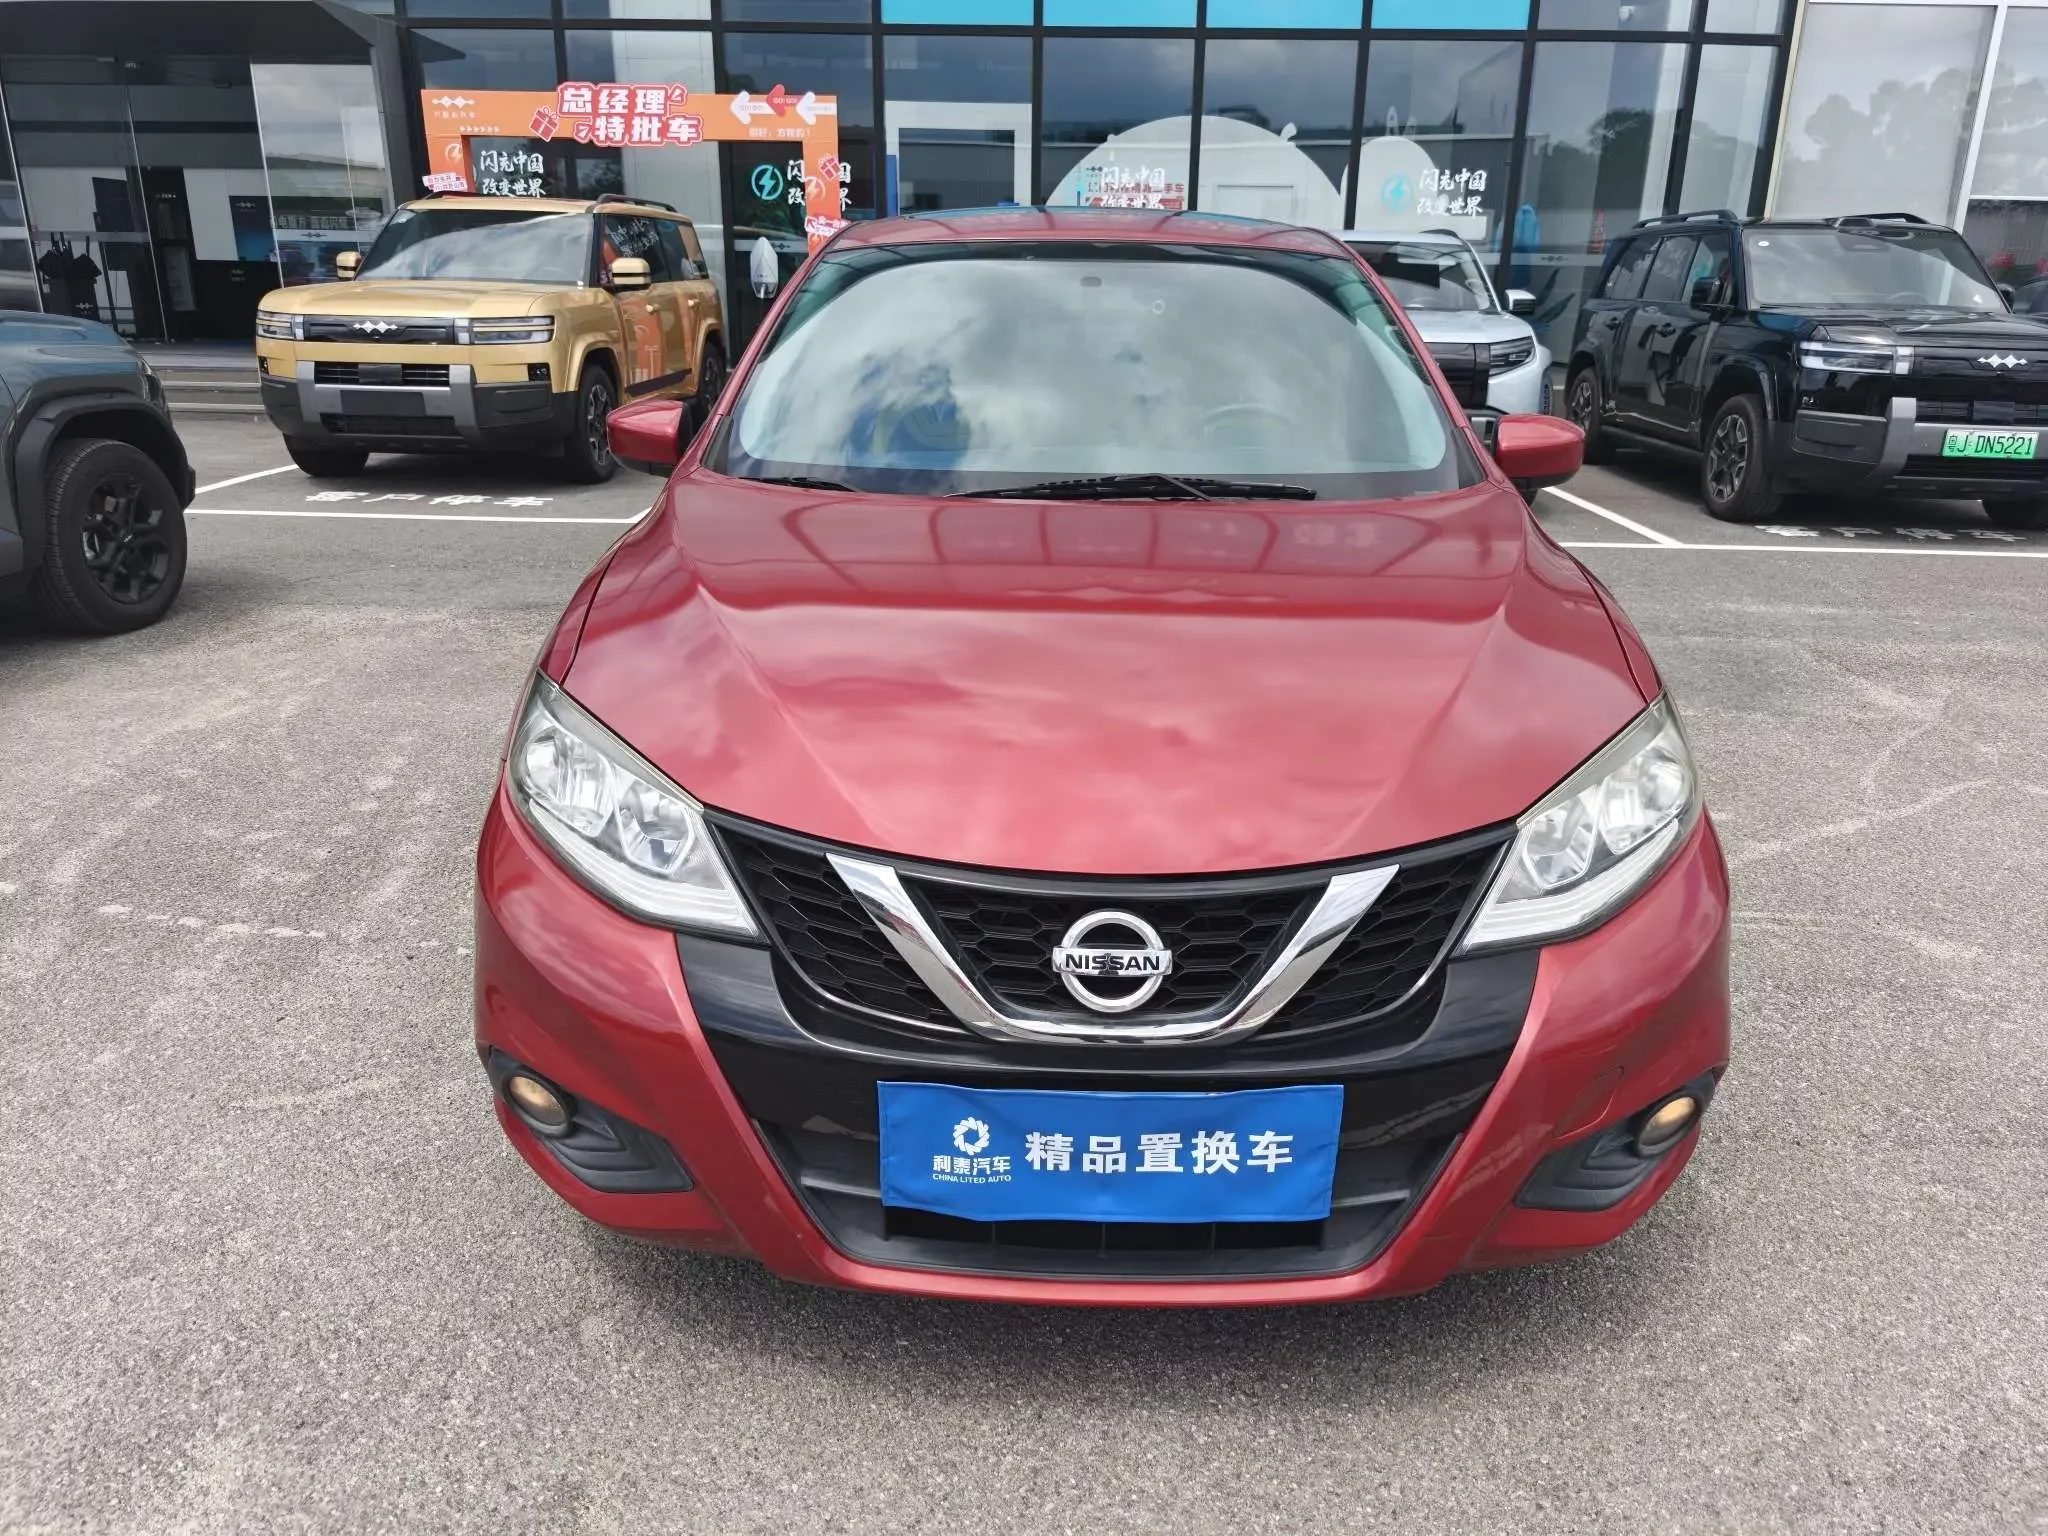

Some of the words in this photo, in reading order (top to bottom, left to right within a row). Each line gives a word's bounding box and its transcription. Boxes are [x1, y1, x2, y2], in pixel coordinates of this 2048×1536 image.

[562, 87, 666, 114] 总经理
[594, 115, 698, 142] 特批车
[480, 150, 544, 174] 闪充中国
[482, 177, 546, 198] 改变世界
[1419, 168, 1487, 192] 闪充中国
[1065, 954, 1160, 971] NISSAN
[1024, 1130, 1294, 1174] 精品置换车
[932, 1155, 1011, 1175] 利泰汽车
[932, 1173, 958, 1183] CHINA
[960, 1176, 986, 1184] LITED
[987, 1174, 1012, 1183] AUTO
